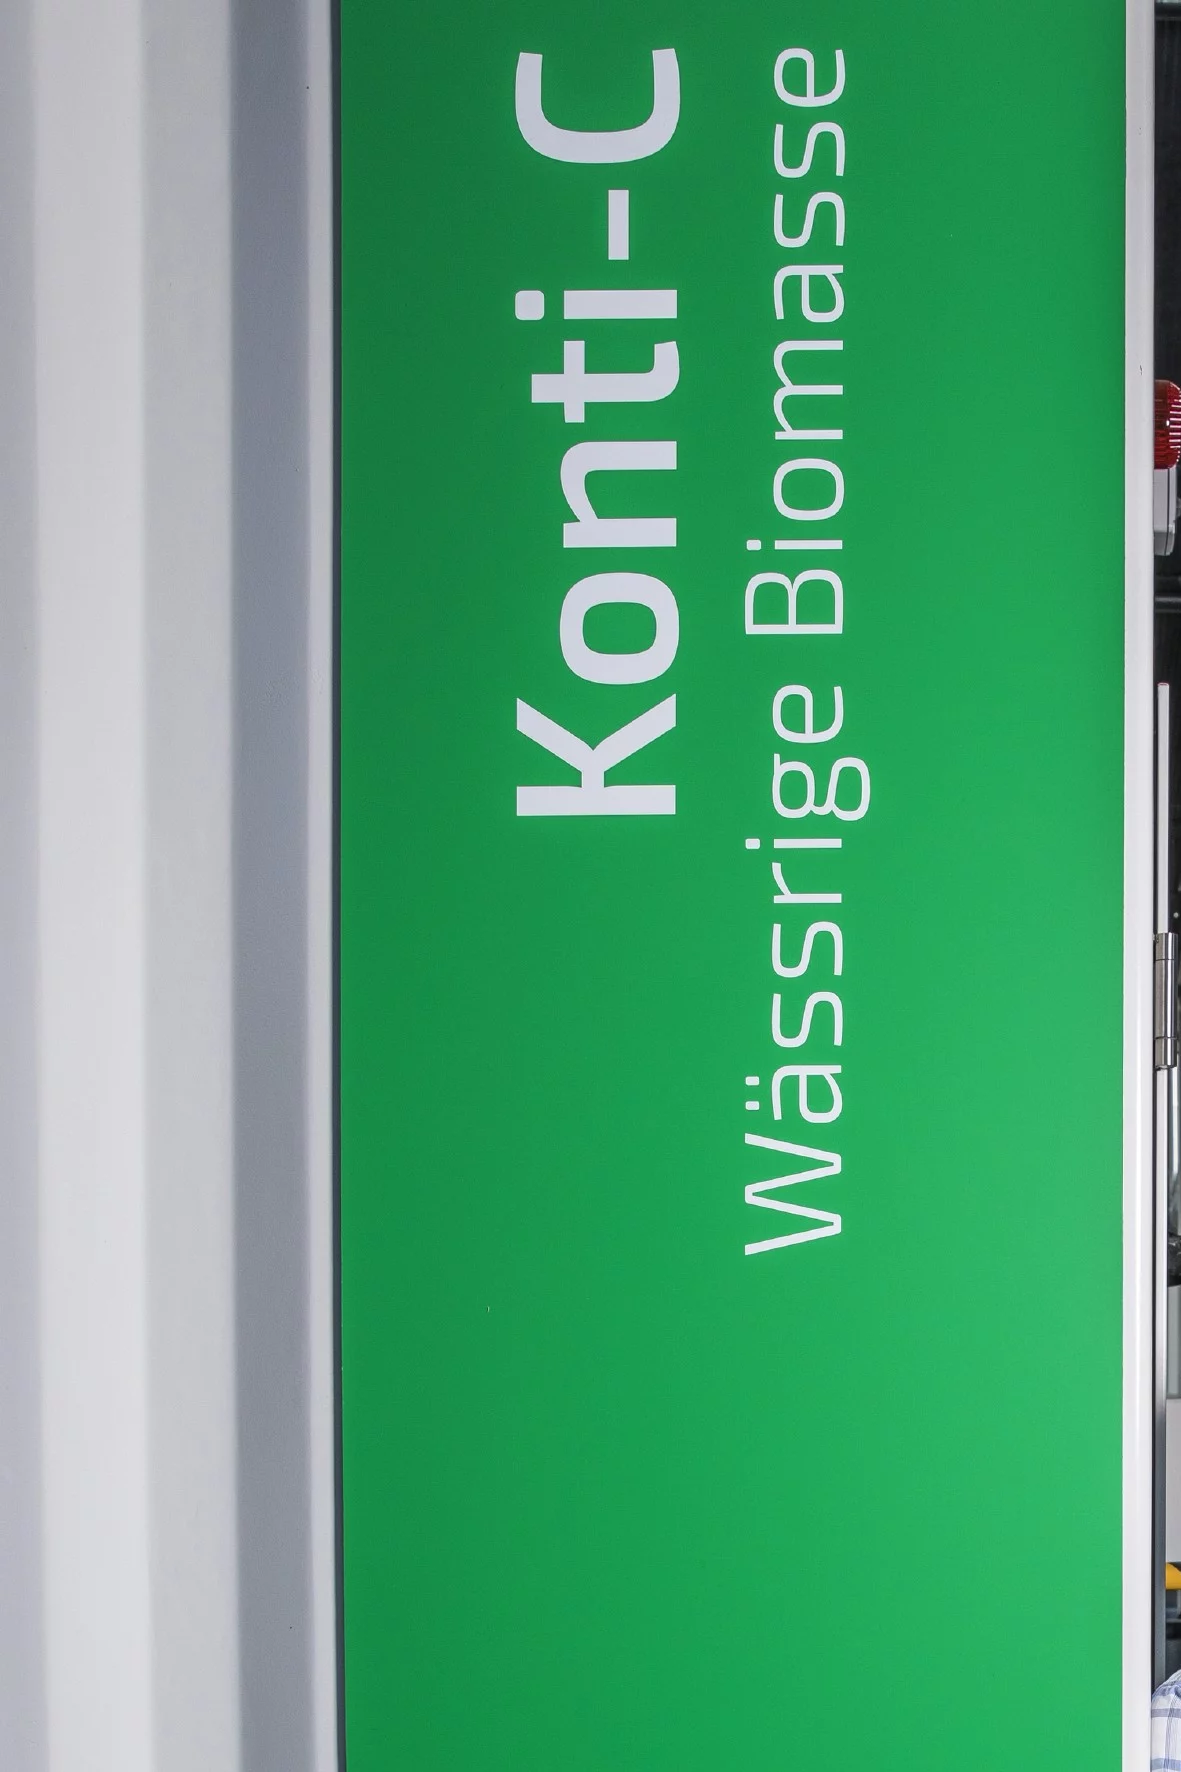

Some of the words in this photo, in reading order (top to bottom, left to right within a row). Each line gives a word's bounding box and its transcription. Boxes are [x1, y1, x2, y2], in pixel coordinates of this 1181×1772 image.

[515, 48, 681, 817] Konti-C
[745, 48, 846, 635] Biomasse
[745, 685, 871, 1256] Wässrige
